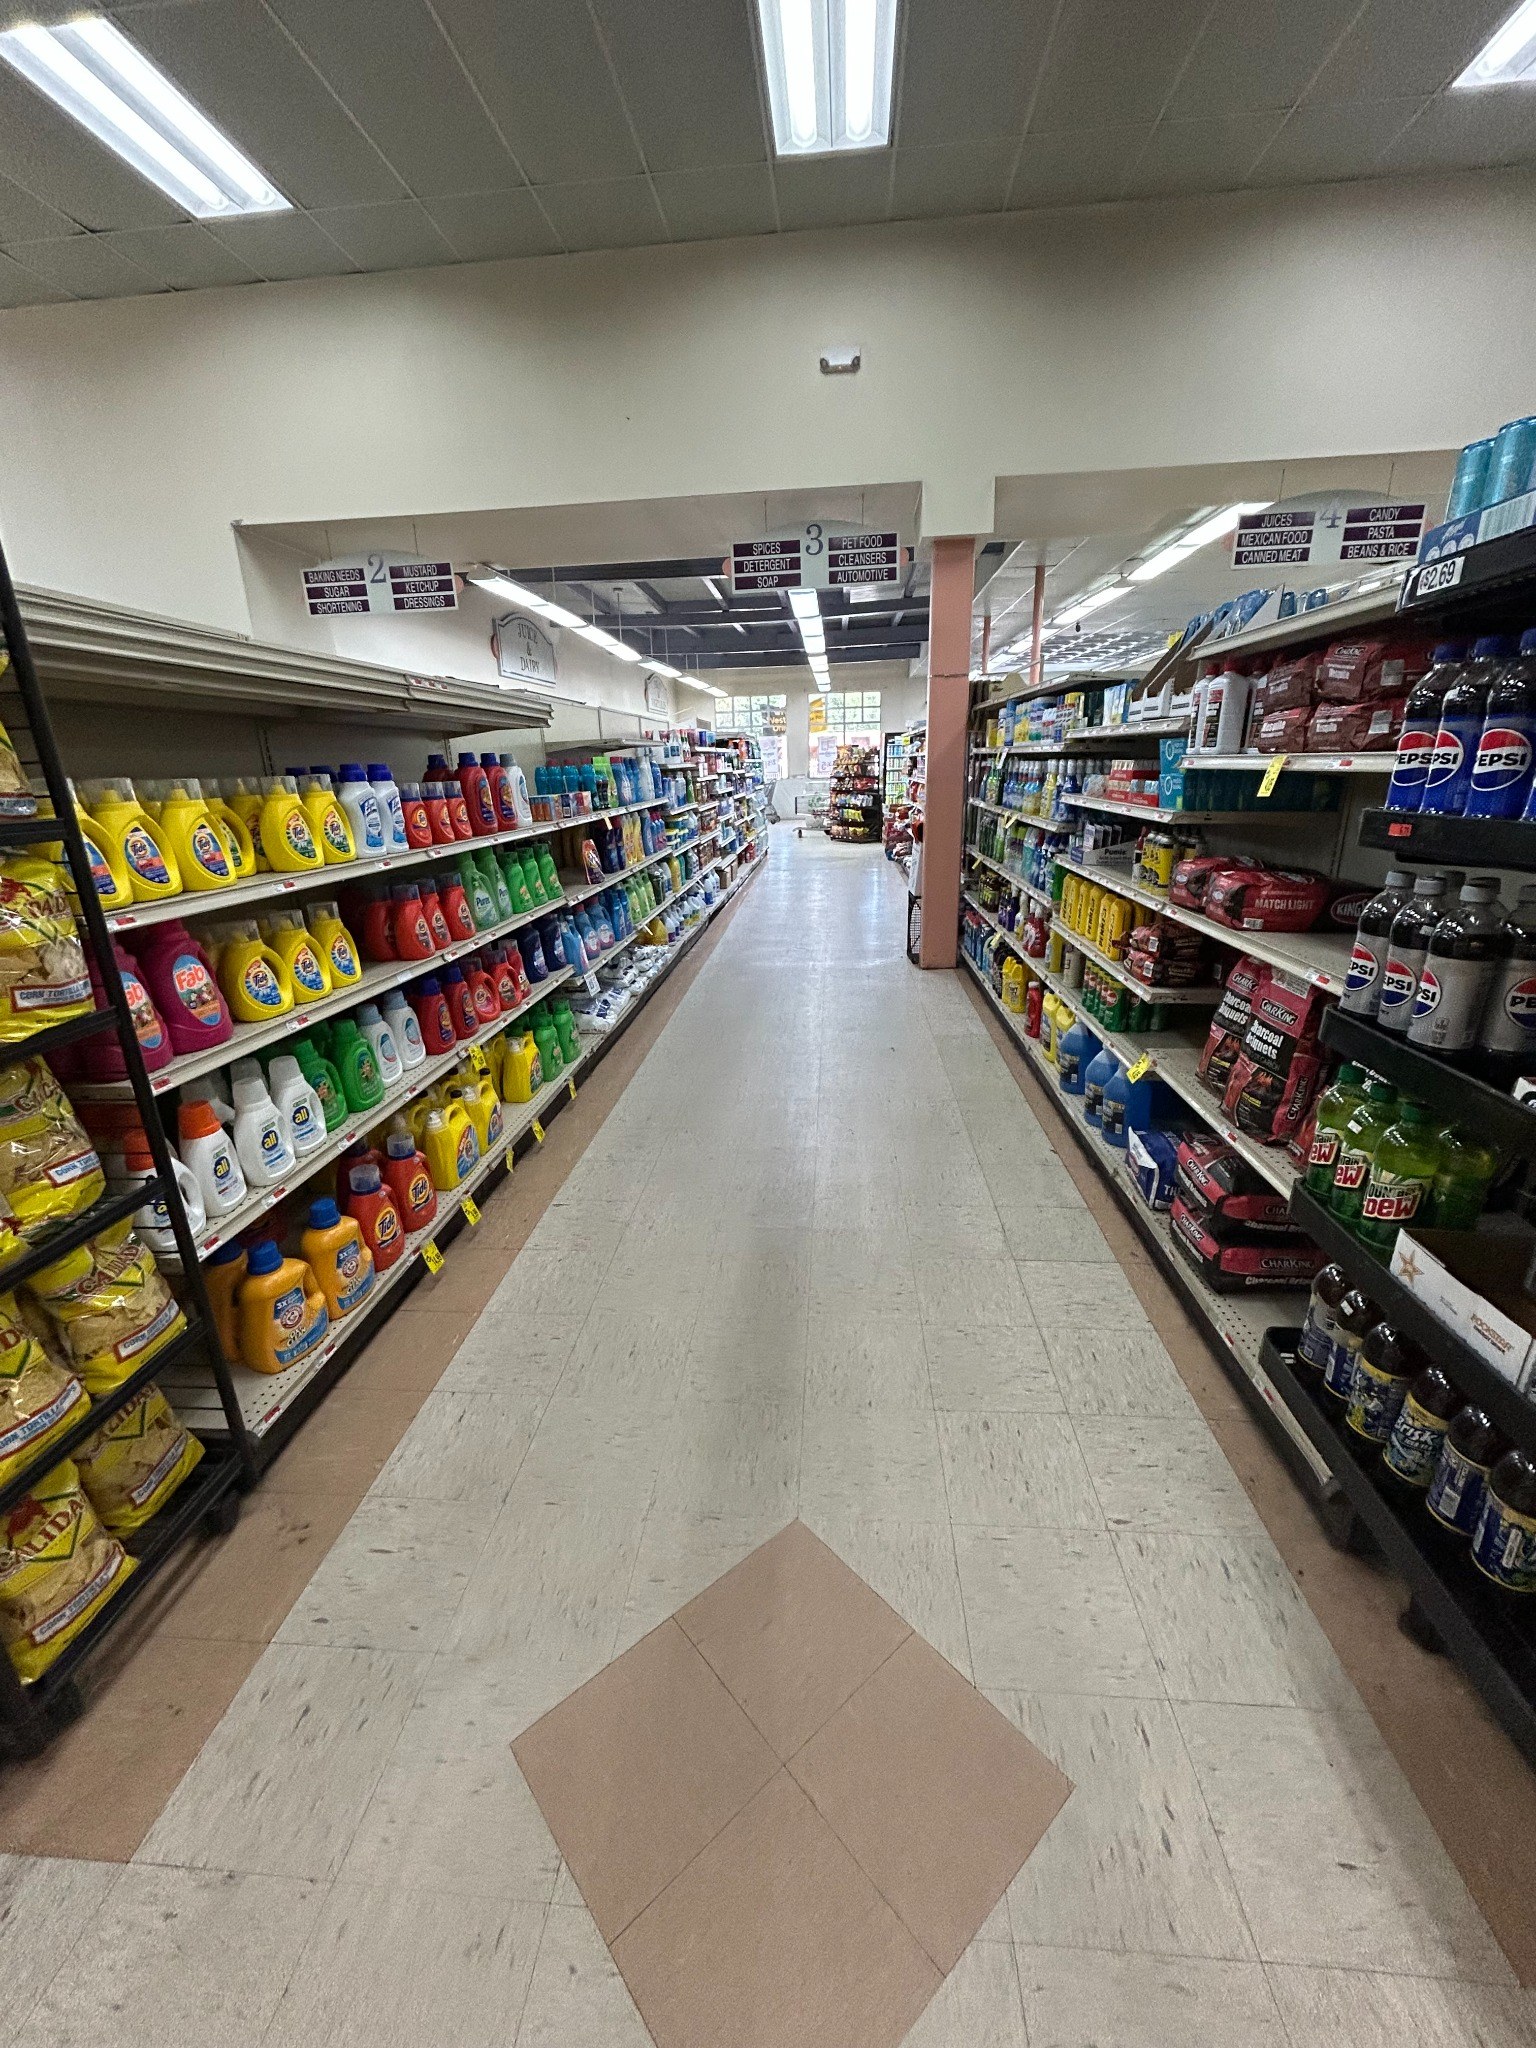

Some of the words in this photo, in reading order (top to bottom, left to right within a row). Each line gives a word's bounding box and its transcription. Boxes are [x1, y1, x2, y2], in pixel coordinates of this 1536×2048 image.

[1261, 513, 1293, 527] JUICES
[1319, 499, 1343, 529] 4
[1368, 507, 1402, 521] CANDY
[805, 524, 824, 556] 3
[1241, 532, 1282, 546] MEXICAN
[1282, 530, 1308, 544] FOOD
[1367, 526, 1395, 539] PASTA
[752, 542, 781, 555] SPICES
[842, 537, 858, 549] PET
[859, 535, 883, 548] FOOD
[1241, 551, 1279, 564] CANNED
[1278, 549, 1303, 562] MEAT
[1347, 545, 1378, 559] BEANS
[1380, 545, 1387, 556] &
[1388, 542, 1411, 556] RICE
[743, 558, 791, 573] DETERGENT
[838, 552, 887, 566] CLEANSERS
[309, 570, 336, 583] BAKING
[336, 569, 361, 581] NEEDS
[367, 553, 387, 584] 2
[403, 564, 437, 577] MUSTARD
[837, 569, 889, 583] AUTOMOTIVE
[405, 580, 440, 593] KETCHUP
[757, 575, 779, 588] SOAP
[324, 585, 350, 598] SUGAR
[316, 601, 363, 614] SHORTENING
[403, 595, 445, 609] DRESSINGS
[517, 623, 538, 644] JUICE
[520, 656, 540, 673] DAIRY
[1399, 752, 1434, 765] EPS
[1432, 752, 1459, 765] PSI
[1478, 752, 1527, 766] EPSI
[1254, 898, 1287, 910] MATCH
[1287, 900, 1315, 911] LIGHT
[1336, 901, 1364, 917] KING
[1350, 961, 1375, 977] PSI
[175, 964, 205, 991] Fab
[1384, 975, 1412, 992] PSI
[124, 982, 144, 1008] ab
[294, 1108, 308, 1123] all
[264, 1131, 277, 1149] all
[216, 1158, 229, 1177] all
[411, 1179, 428, 1202] Tide
[377, 1214, 395, 1238] Tide
